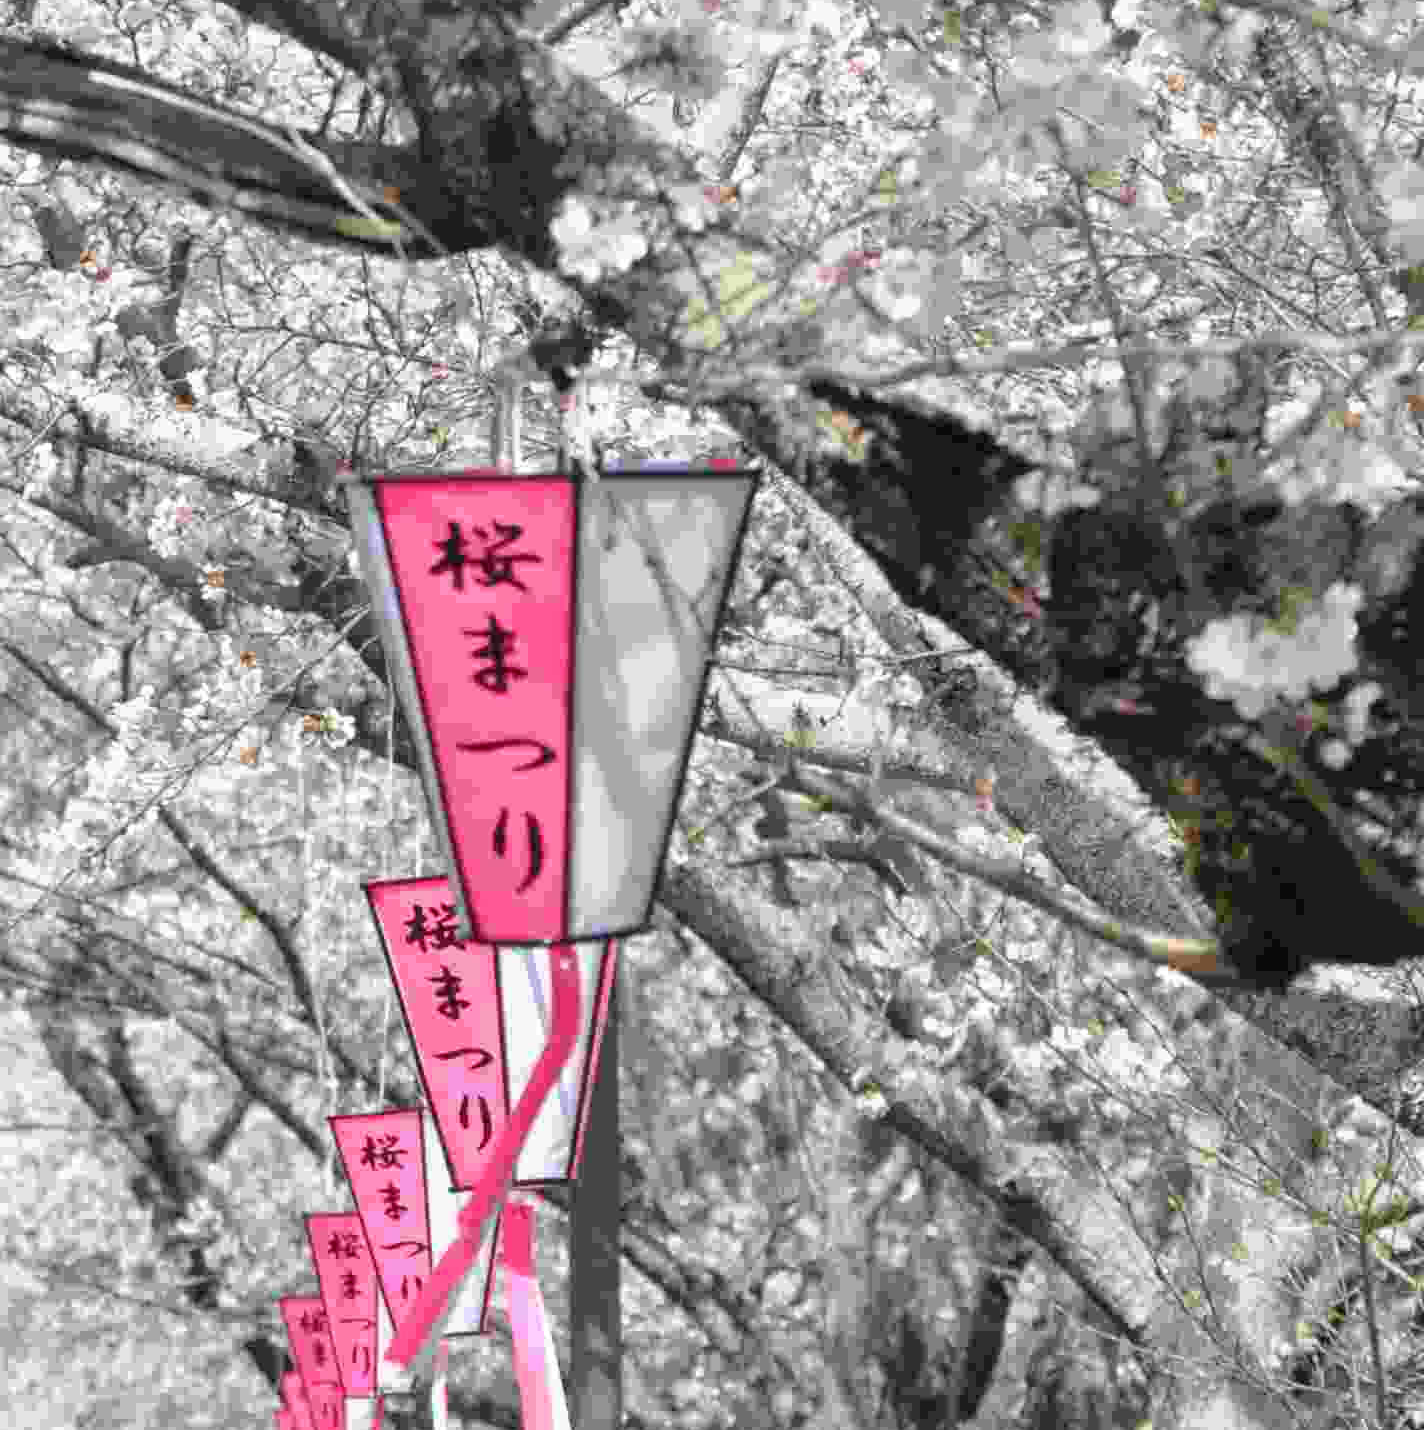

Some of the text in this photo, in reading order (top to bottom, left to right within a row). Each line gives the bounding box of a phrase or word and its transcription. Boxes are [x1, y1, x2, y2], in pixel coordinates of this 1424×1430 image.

[428, 520, 557, 895] 桜まつり
[404, 903, 494, 1153] 桜まつり
[327, 1231, 376, 1379] 桜まつり
